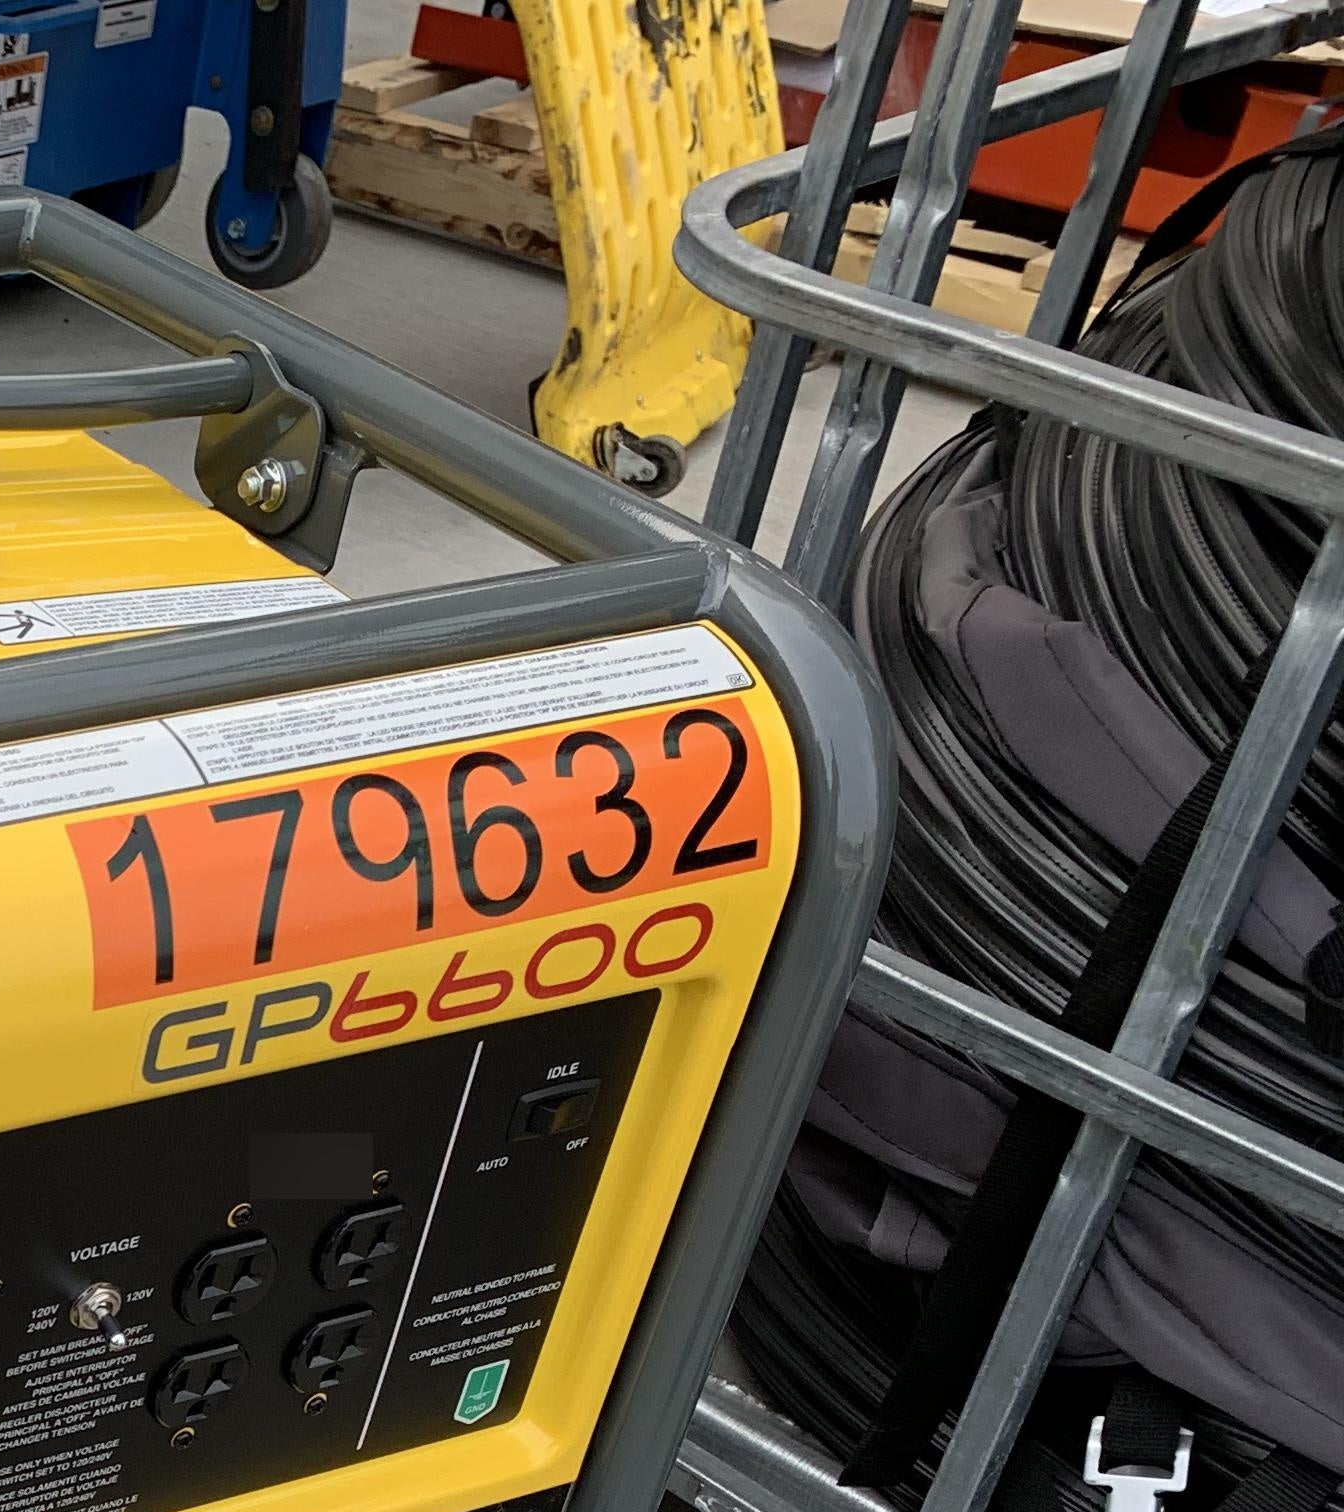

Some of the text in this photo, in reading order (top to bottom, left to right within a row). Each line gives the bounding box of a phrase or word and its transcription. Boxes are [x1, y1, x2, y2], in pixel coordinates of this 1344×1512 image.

[106, 709, 759, 986] 179632
[141, 902, 713, 1084] GP6600
[546, 1062, 580, 1080] IDLE
[565, 1136, 589, 1151] OFF
[475, 1156, 509, 1172] AUTO
[71, 1235, 140, 1262] VOLTAGE
[126, 1287, 154, 1302] 120V
[31, 1303, 60, 1319] 120V
[26, 1317, 57, 1333] 240V
[5, 1344, 106, 1377] BEFORE SWITCHING
[17, 1343, 67, 1363] SET MAIN
[24, 1353, 137, 1388] AJUSTE INTERRUPTOR
[1, 1371, 146, 1415] ANTES DE CAMBIAR VOLTAJE
[31, 1377, 84, 1397] PRINCIPAL
[84, 1375, 94, 1385] A
[43, 1394, 117, 1419] DISJONCTEUR
[92, 1400, 129, 1418] AVANT
[129, 1396, 145, 1408] DE
[464, 1401, 486, 1415] GND
[51, 1420, 96, 1438] TENSION
[14, 1458, 42, 1472] ONLY
[42, 1450, 74, 1465] WHEN
[74, 1438, 120, 1457] VOLTAGE
[16, 1474, 78, 1497] SOLAMENTE
[78, 1463, 122, 1481] CUANDO
[34, 1464, 55, 1478] SET
[56, 1461, 71, 1472] TO
[59, 1485, 75, 1497] DE
[75, 1474, 119, 1492] VOLTAJE
[124, 1493, 139, 1505] LE
